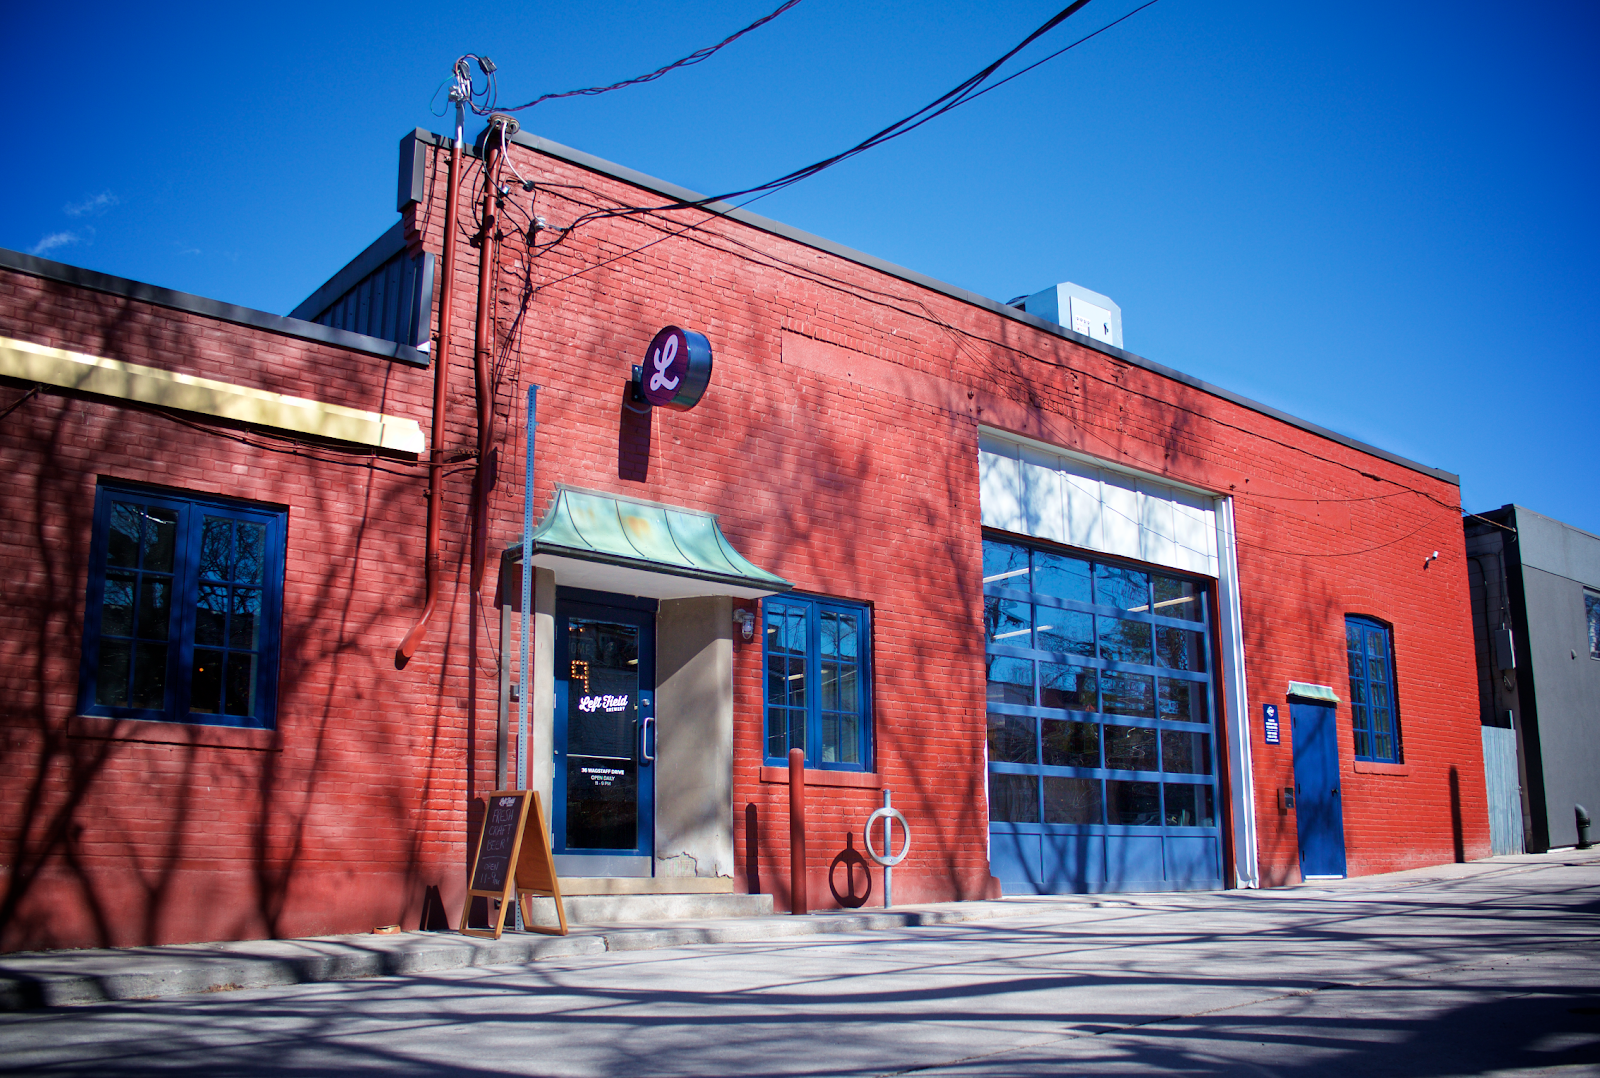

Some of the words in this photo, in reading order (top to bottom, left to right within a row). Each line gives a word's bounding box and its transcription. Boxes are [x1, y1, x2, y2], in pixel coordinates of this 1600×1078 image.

[650, 334, 679, 391] L
[579, 695, 602, 712] Left
[602, 694, 628, 708] Field
[492, 809, 515, 823] FRESH
[489, 823, 513, 836] CRAFT
[484, 861, 500, 871] OPEN
